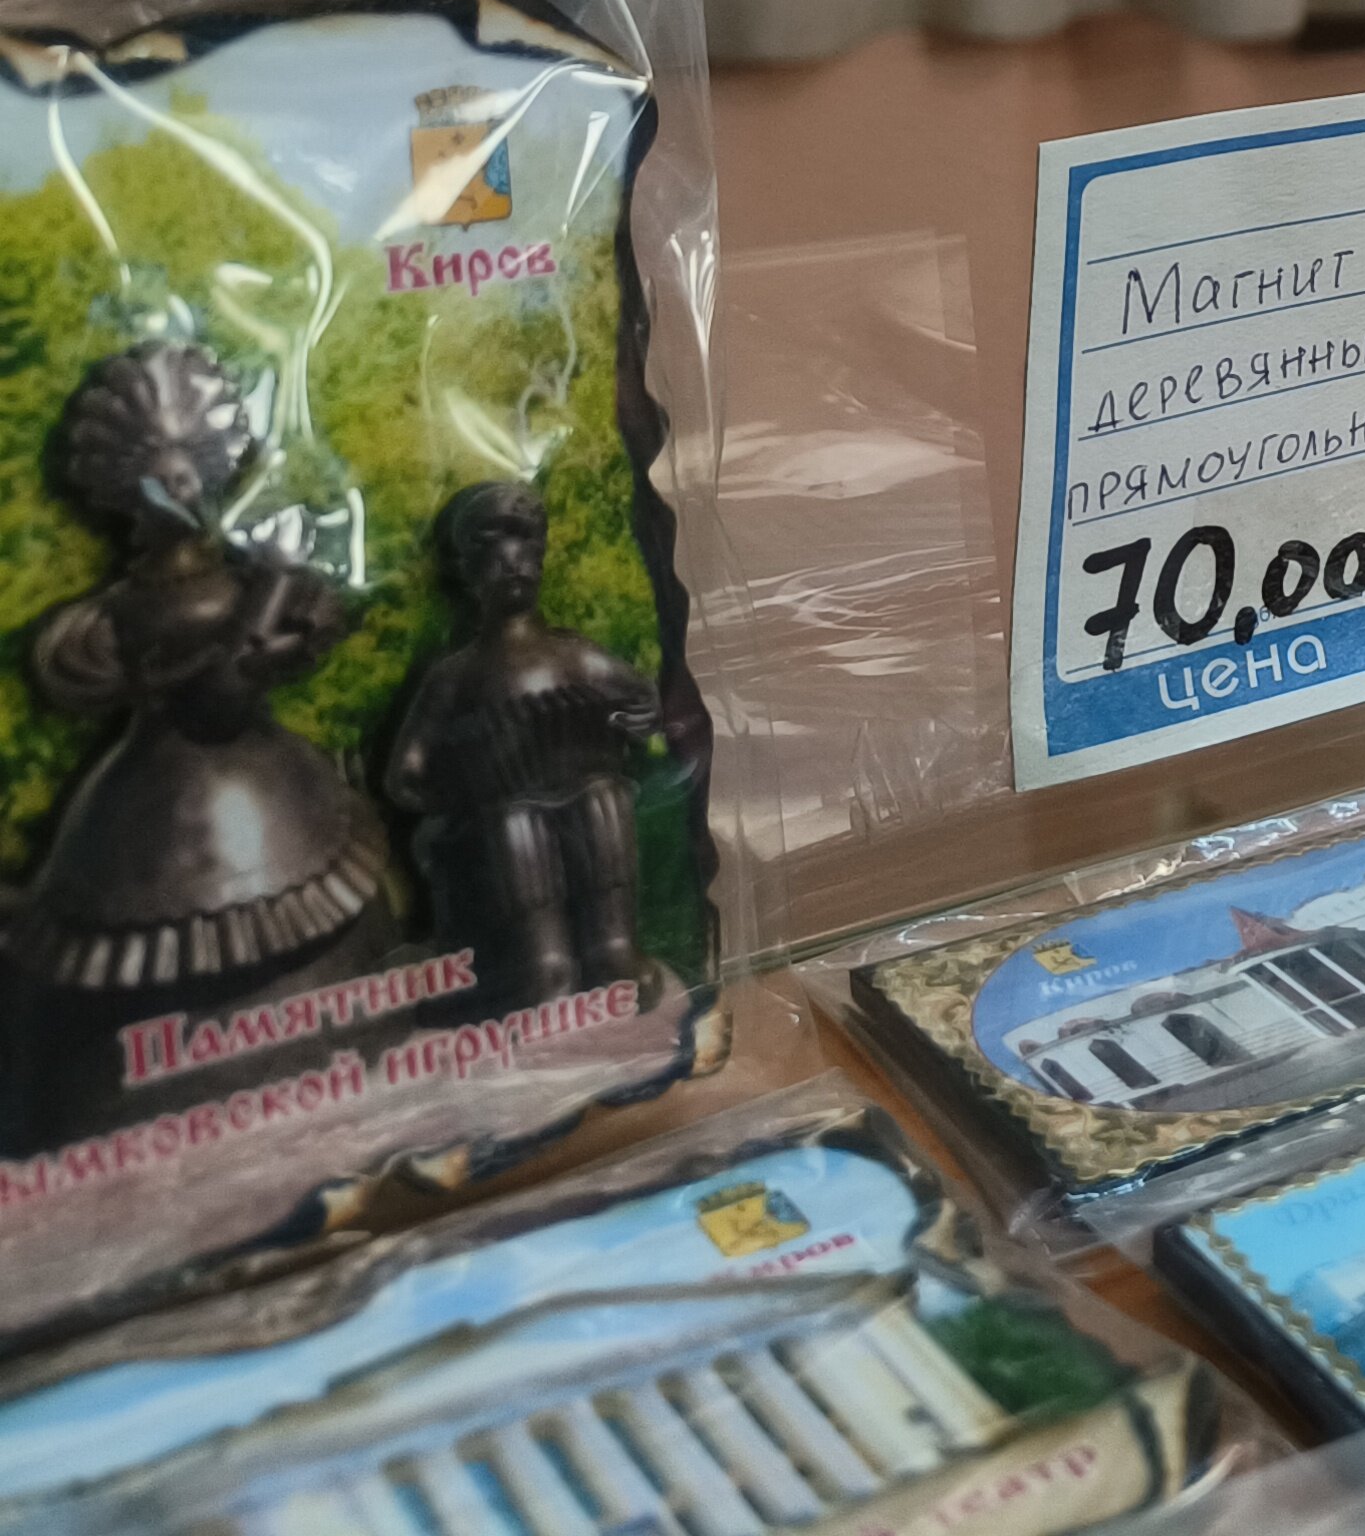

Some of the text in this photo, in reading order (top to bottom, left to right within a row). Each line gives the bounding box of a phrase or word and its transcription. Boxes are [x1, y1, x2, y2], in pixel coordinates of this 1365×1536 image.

[385, 242, 557, 297] Киров
[1121, 250, 1354, 335] Магнит
[1157, 631, 1328, 711] цена
[121, 948, 477, 1087] Памятник
